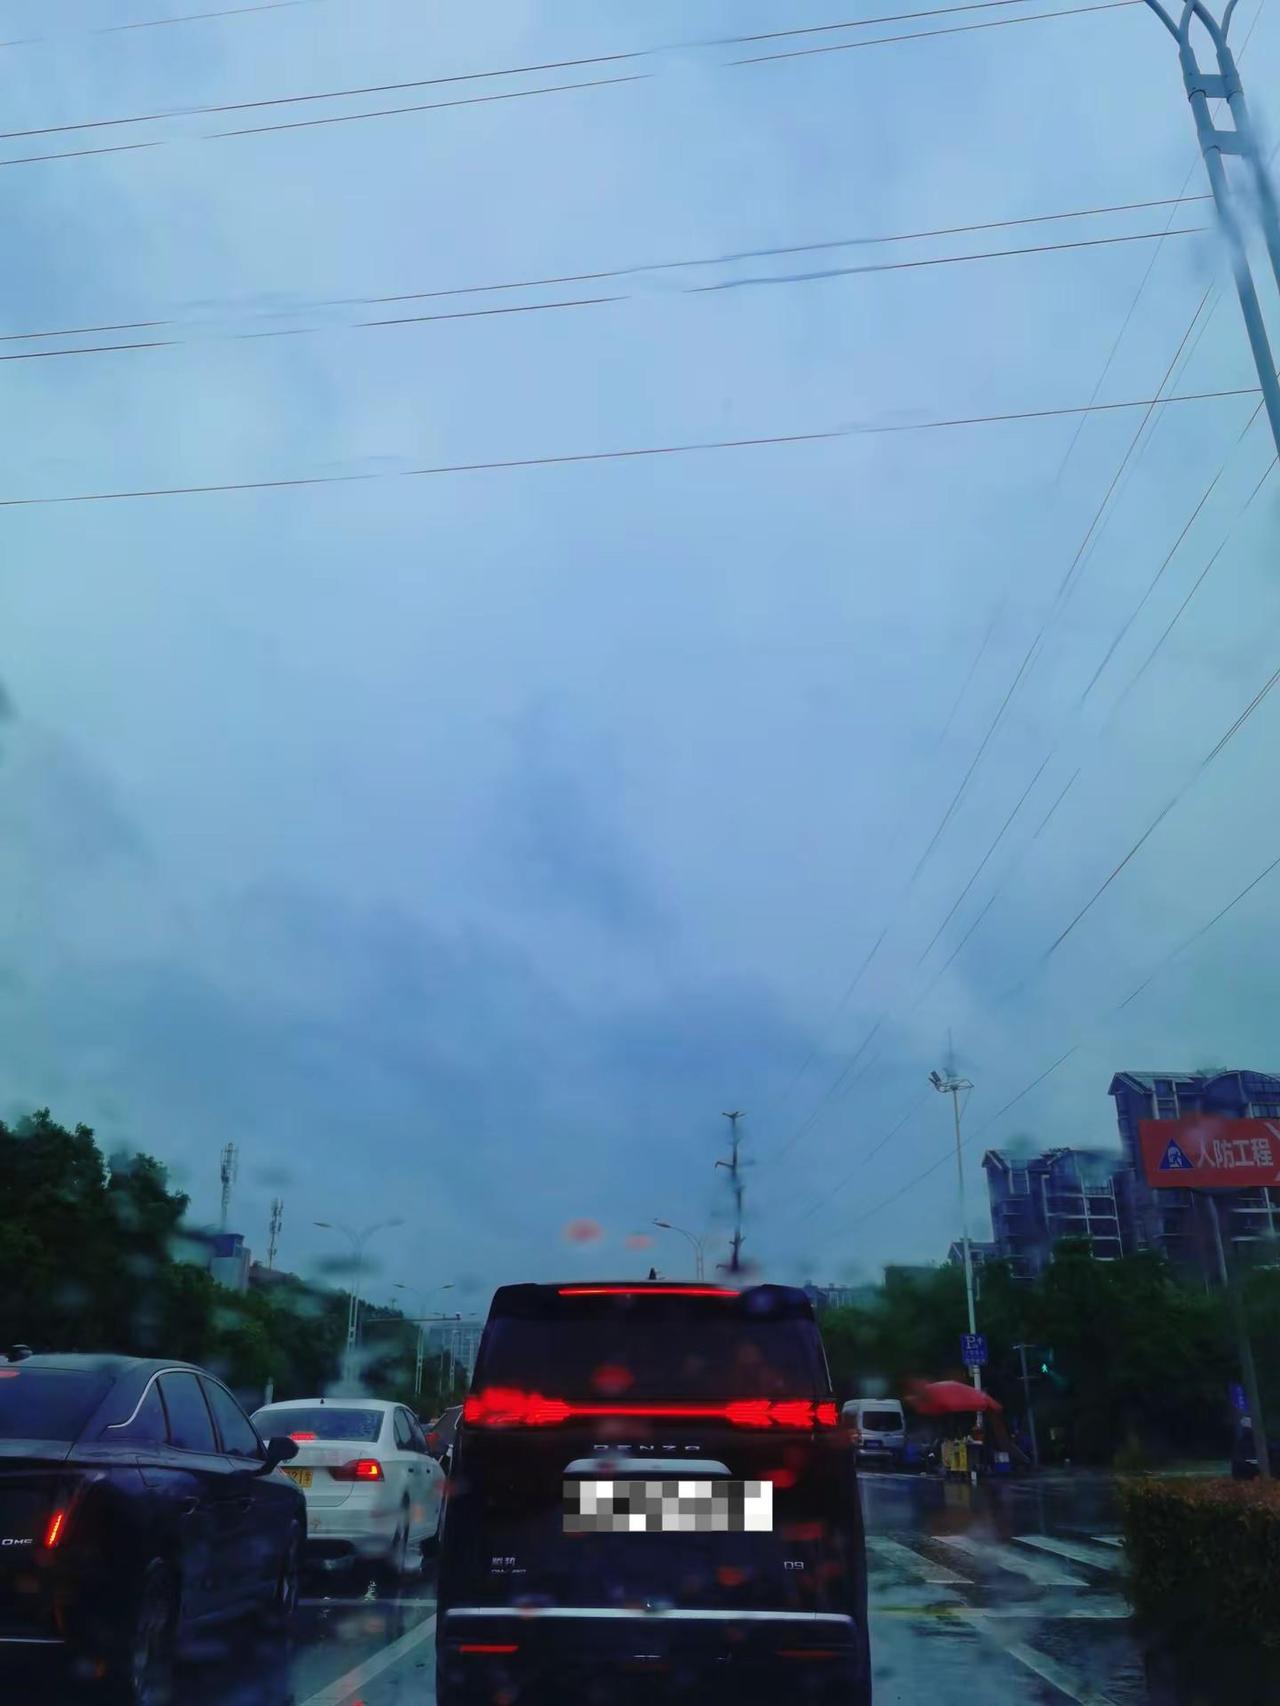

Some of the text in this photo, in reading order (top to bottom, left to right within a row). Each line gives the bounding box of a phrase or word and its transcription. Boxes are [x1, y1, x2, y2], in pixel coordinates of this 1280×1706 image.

[1198, 1137, 1274, 1168] 人防工程
[966, 1336, 976, 1349] P
